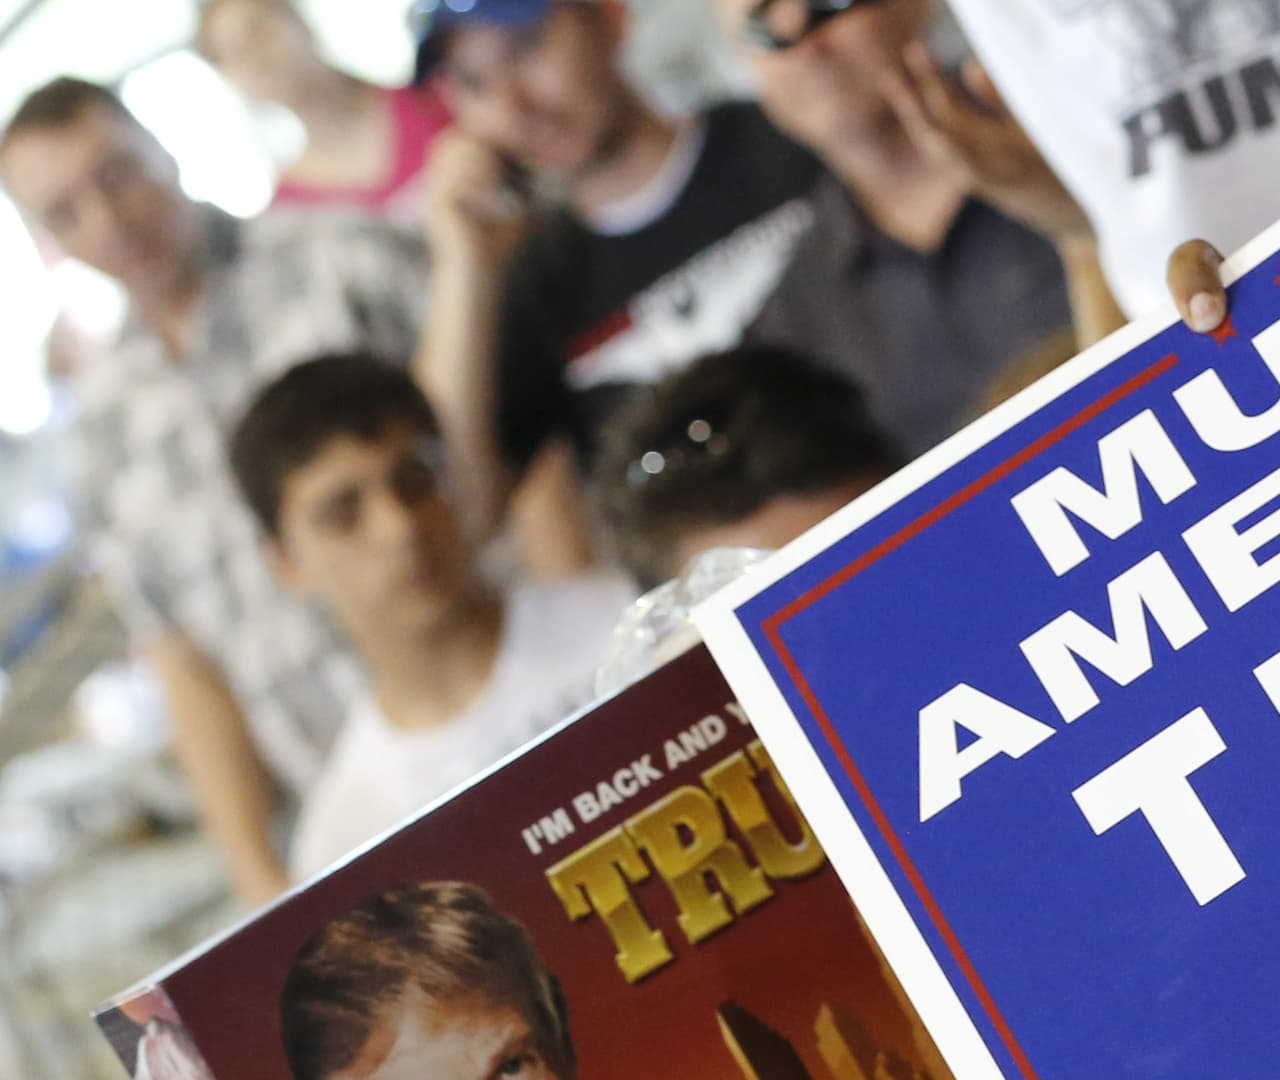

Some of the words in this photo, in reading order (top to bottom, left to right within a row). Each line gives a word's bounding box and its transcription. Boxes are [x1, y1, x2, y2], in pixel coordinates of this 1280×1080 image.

[521, 807, 576, 855] I'M
[572, 753, 663, 824] BACK
[663, 714, 728, 771] AND
[545, 738, 829, 985] TRU
